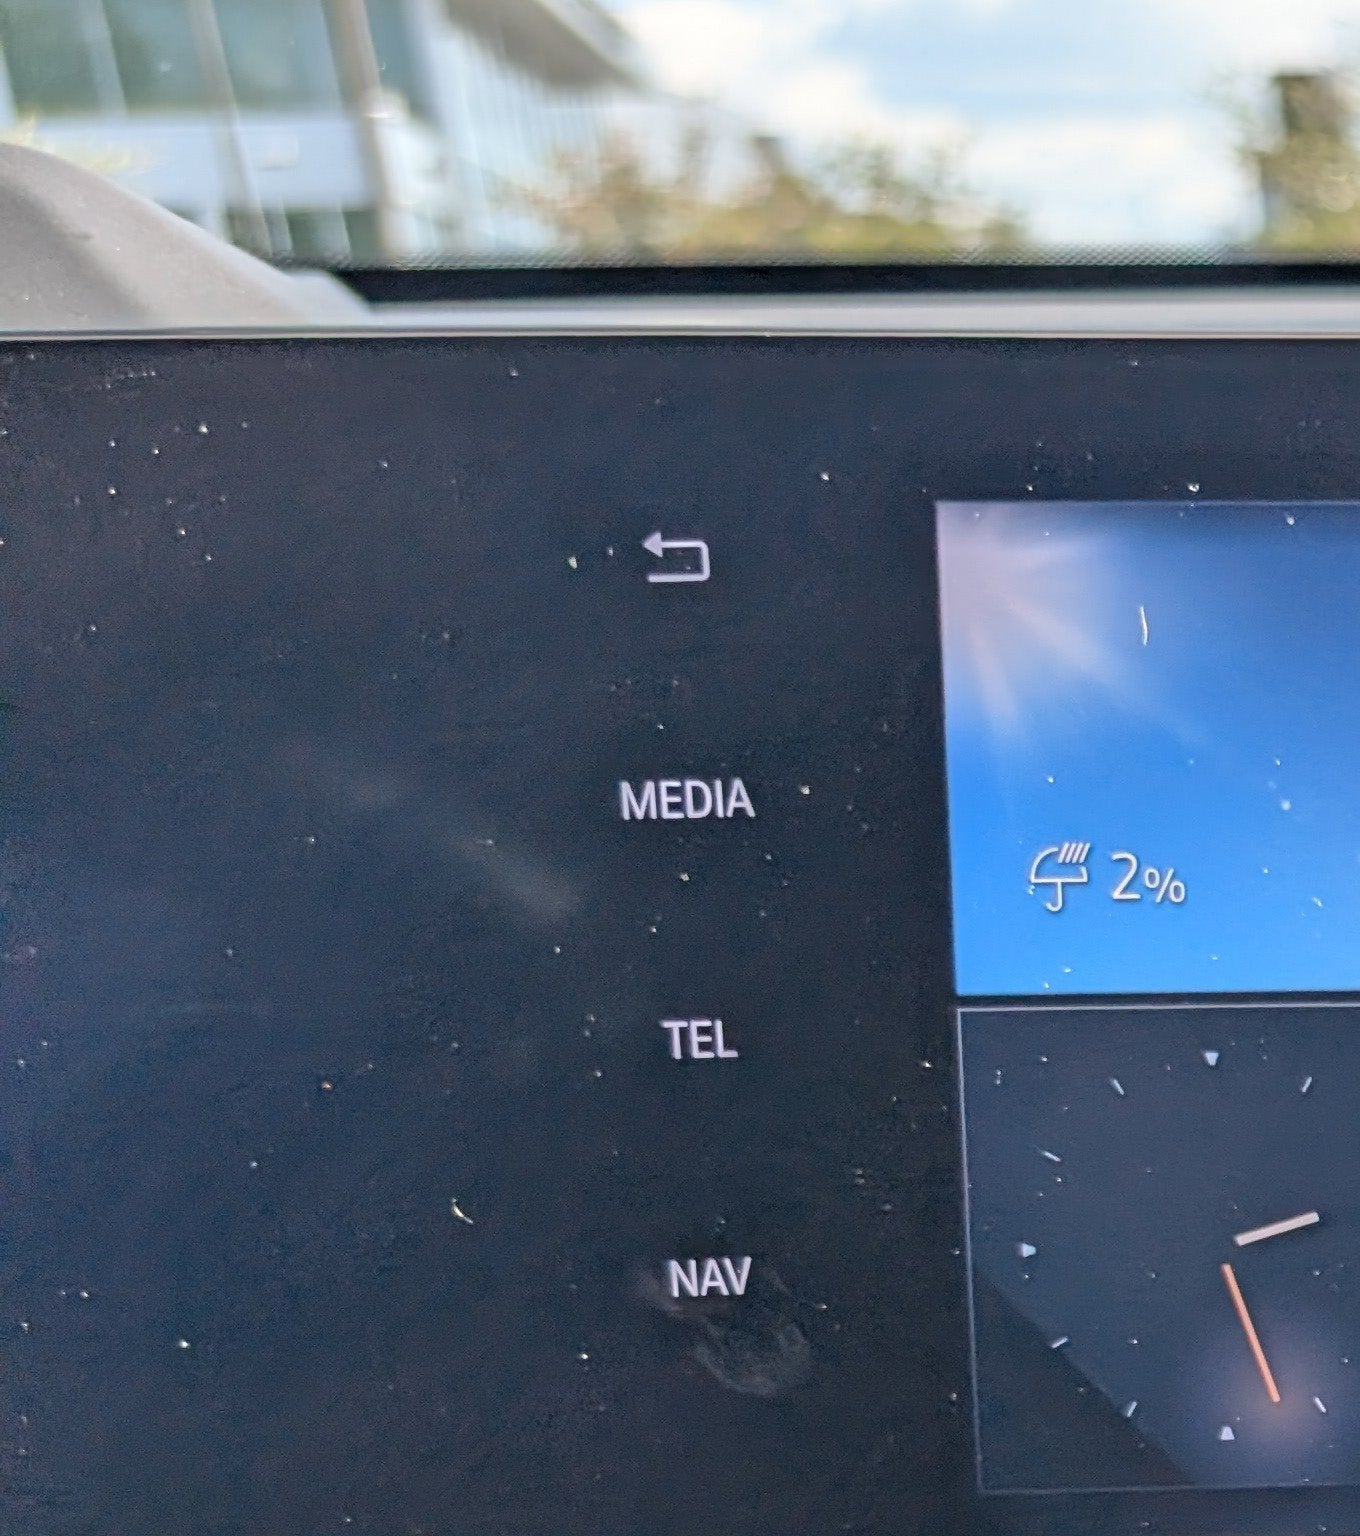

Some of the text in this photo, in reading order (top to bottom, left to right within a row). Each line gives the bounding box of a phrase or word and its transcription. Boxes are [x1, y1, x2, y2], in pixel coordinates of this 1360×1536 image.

[620, 777, 757, 820] MEDIA
[1111, 852, 1187, 904] 2%
[660, 1018, 740, 1060] TEL
[669, 1256, 752, 1298] NAV
